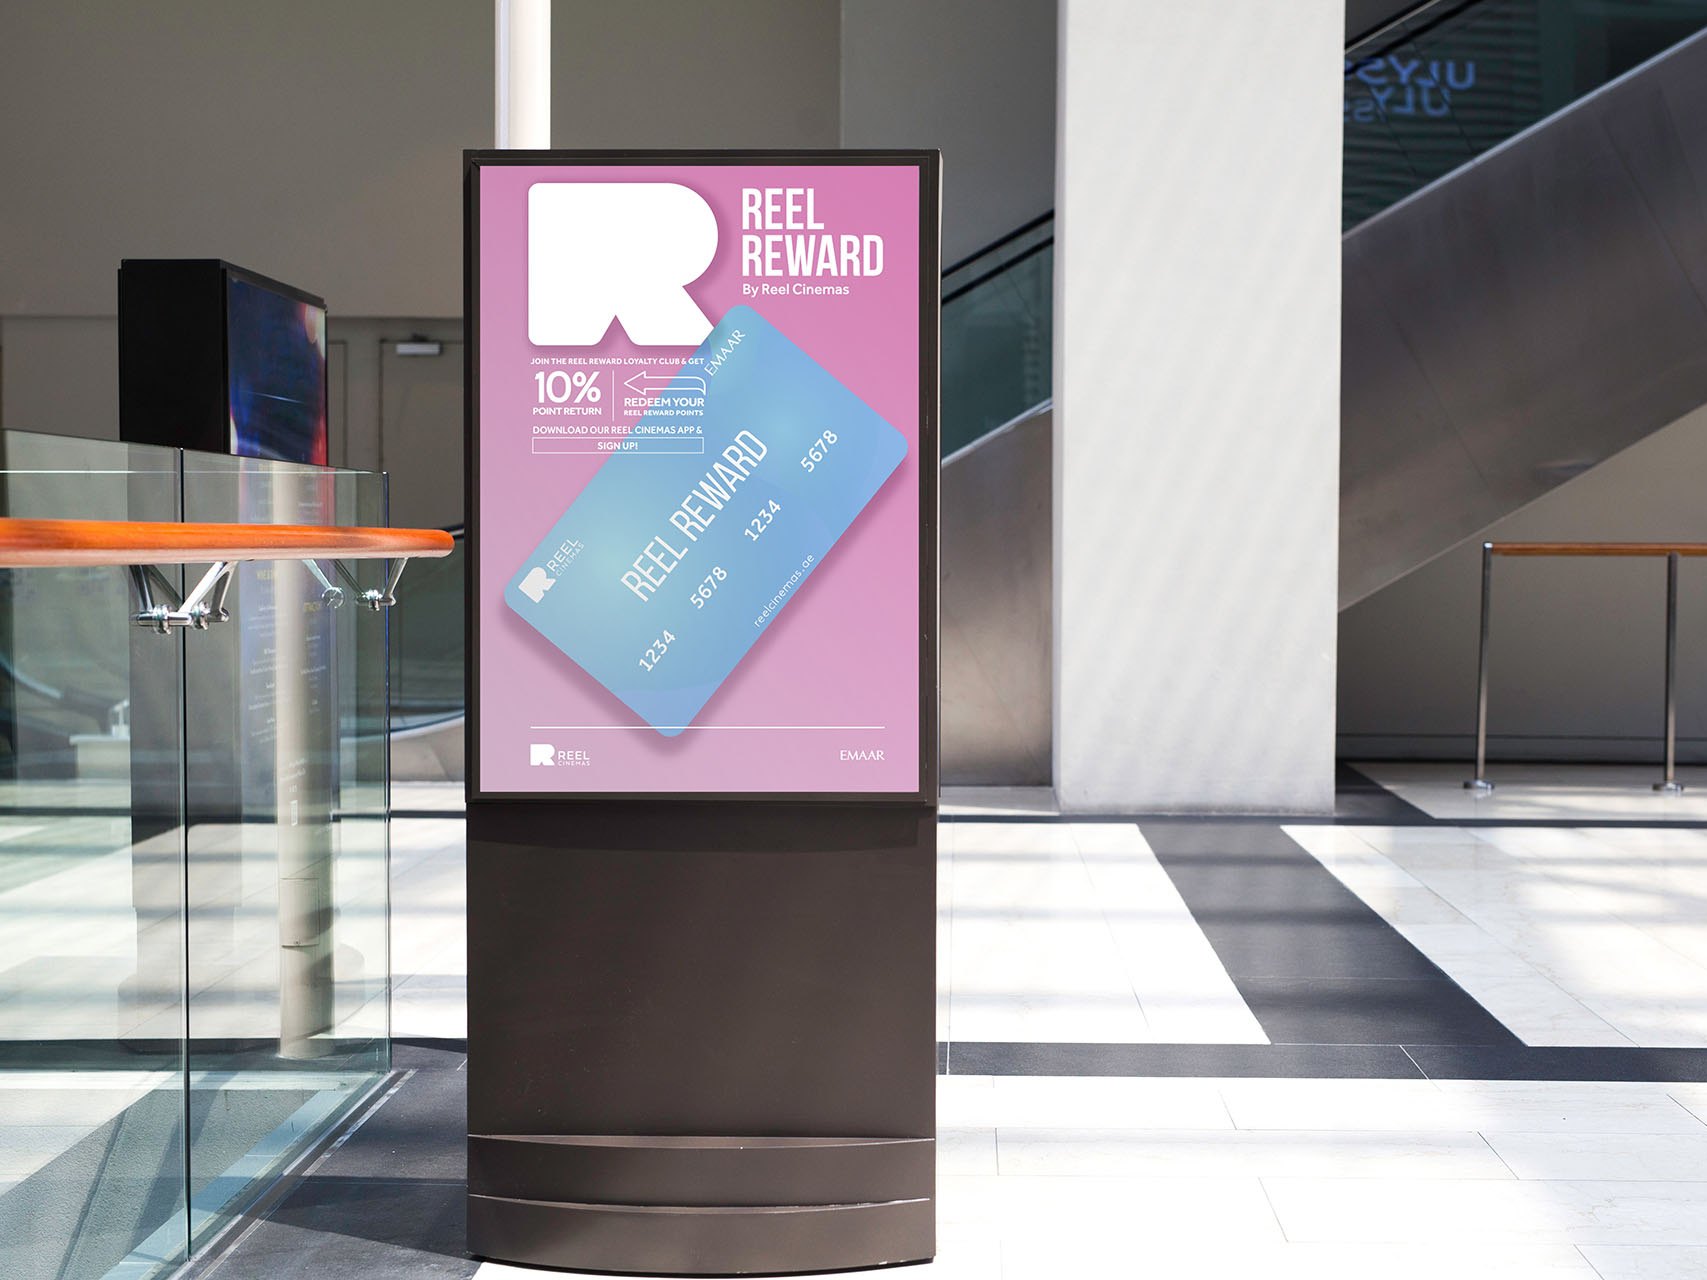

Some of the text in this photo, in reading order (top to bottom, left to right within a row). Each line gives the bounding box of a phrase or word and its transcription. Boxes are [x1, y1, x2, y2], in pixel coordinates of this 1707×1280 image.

[742, 188, 825, 230] REEL
[742, 235, 885, 277] REWARD
[742, 283, 850, 296] By Reel Cinemas
[704, 328, 746, 376] EMAAR
[534, 371, 602, 403] 10%
[624, 398, 705, 407] REDEEM YOUR
[532, 407, 602, 416] POINT RETURN
[532, 426, 703, 434] DOWNLOAD OUR REEL CINEMAS APP &
[597, 442, 638, 450] SIGN UP!
[620, 430, 768, 602] REEL REWARD
[546, 538, 579, 572] REEL
[556, 543, 584, 577] CINEMAS
[639, 429, 838, 672] 1234 5678 1234 5678
[754, 553, 815, 628] reelcinemas.ae
[558, 751, 590, 760] REEL
[840, 750, 885, 760] EMAAR
